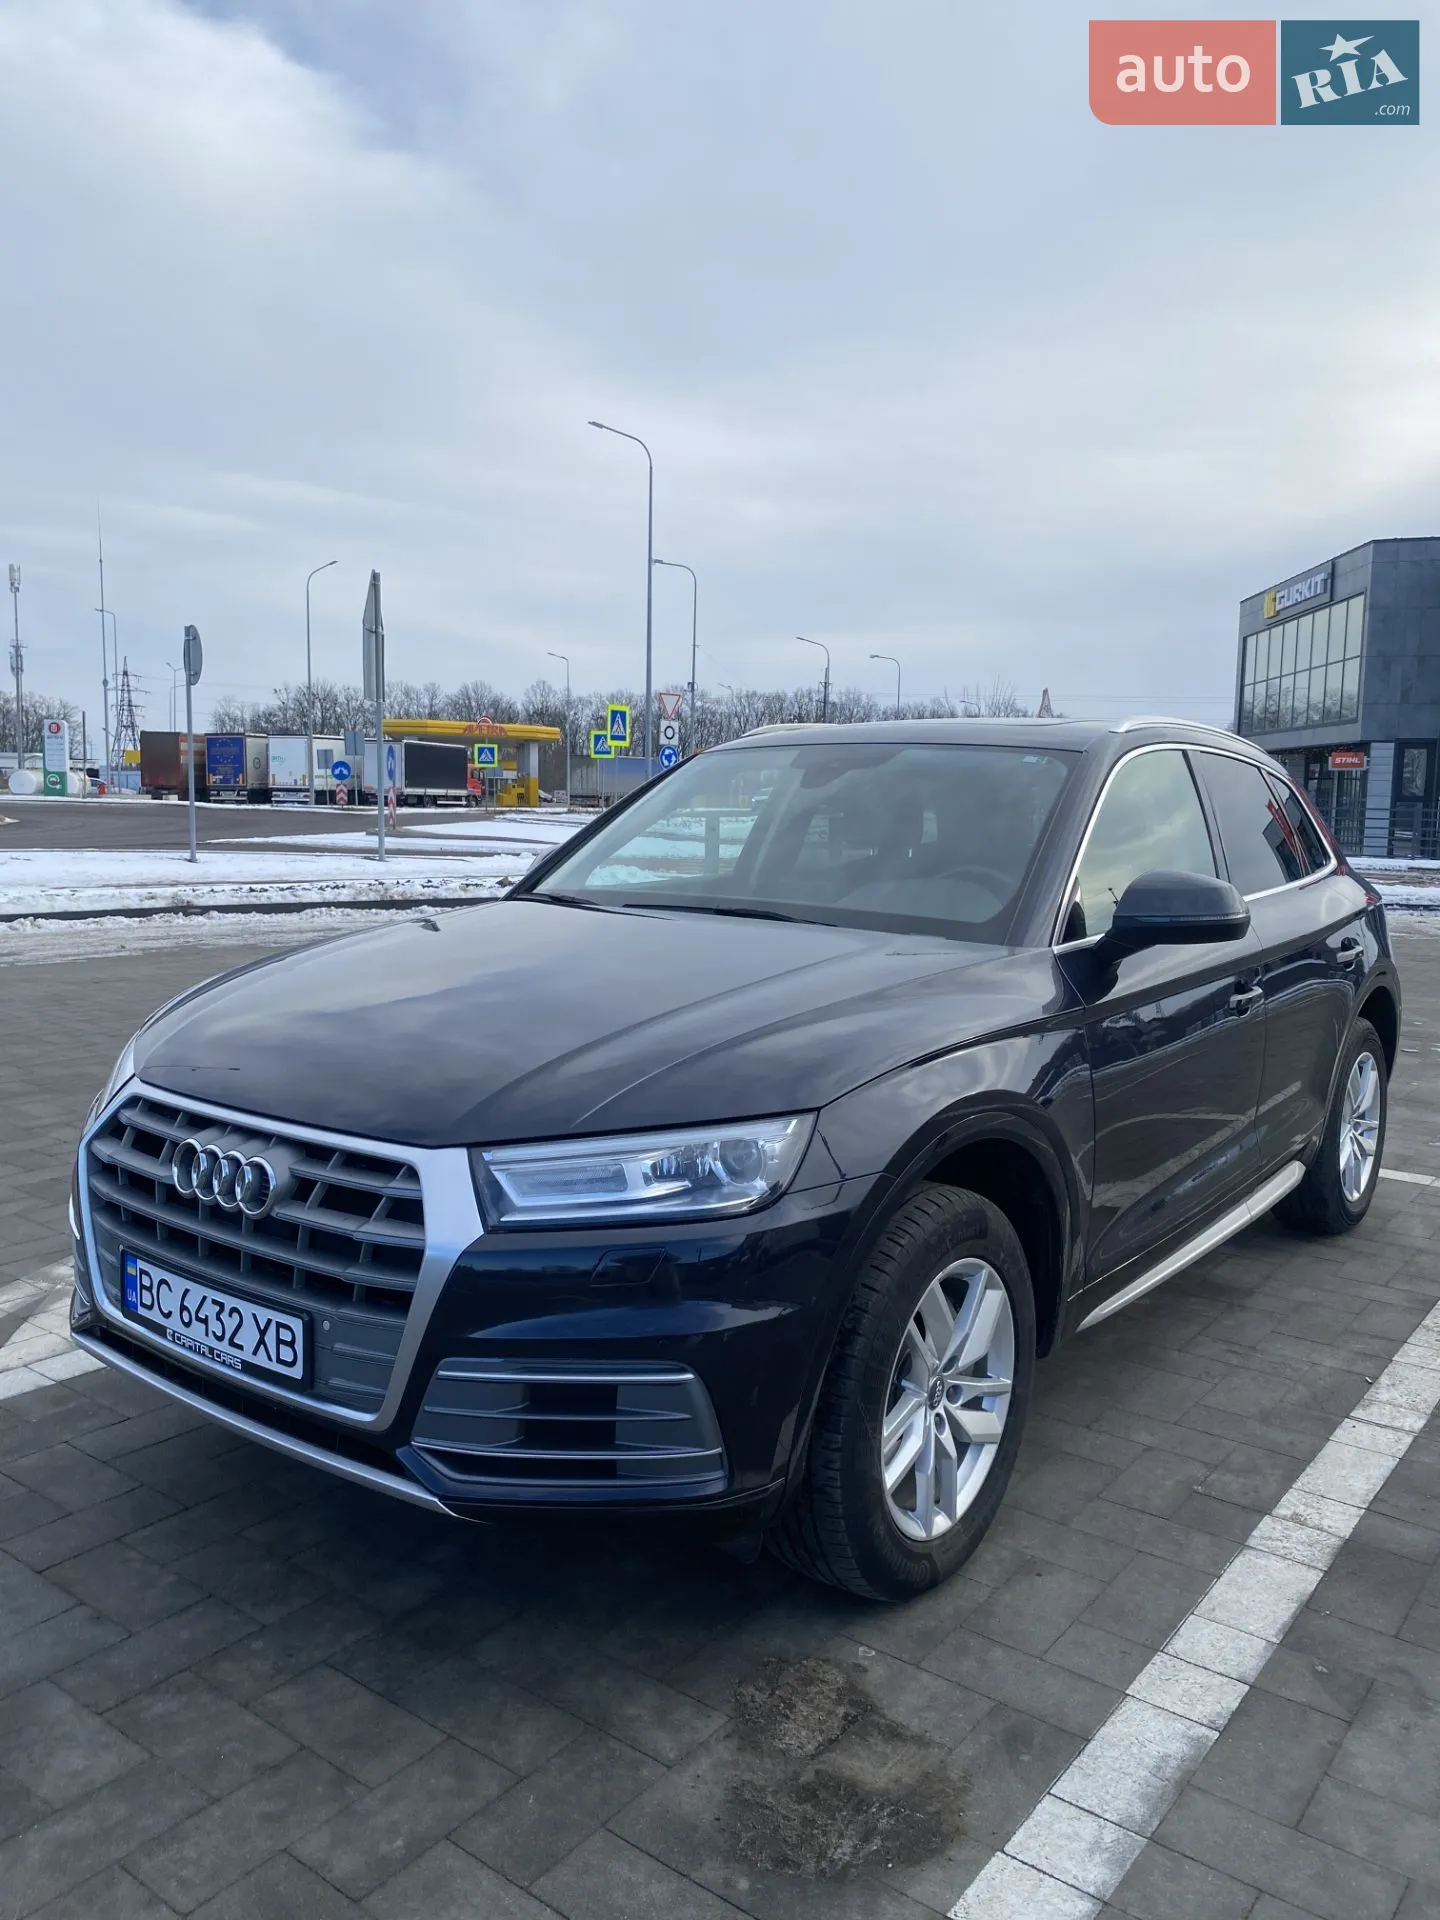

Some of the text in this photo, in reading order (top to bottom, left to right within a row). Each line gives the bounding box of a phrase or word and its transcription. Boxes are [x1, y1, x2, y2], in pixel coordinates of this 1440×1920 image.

[127, 1288, 137, 1304] UA
[138, 1267, 298, 1368] BC 6432 XB
[175, 1332, 213, 1358] CAPITAL
[213, 1349, 242, 1370] CARS
